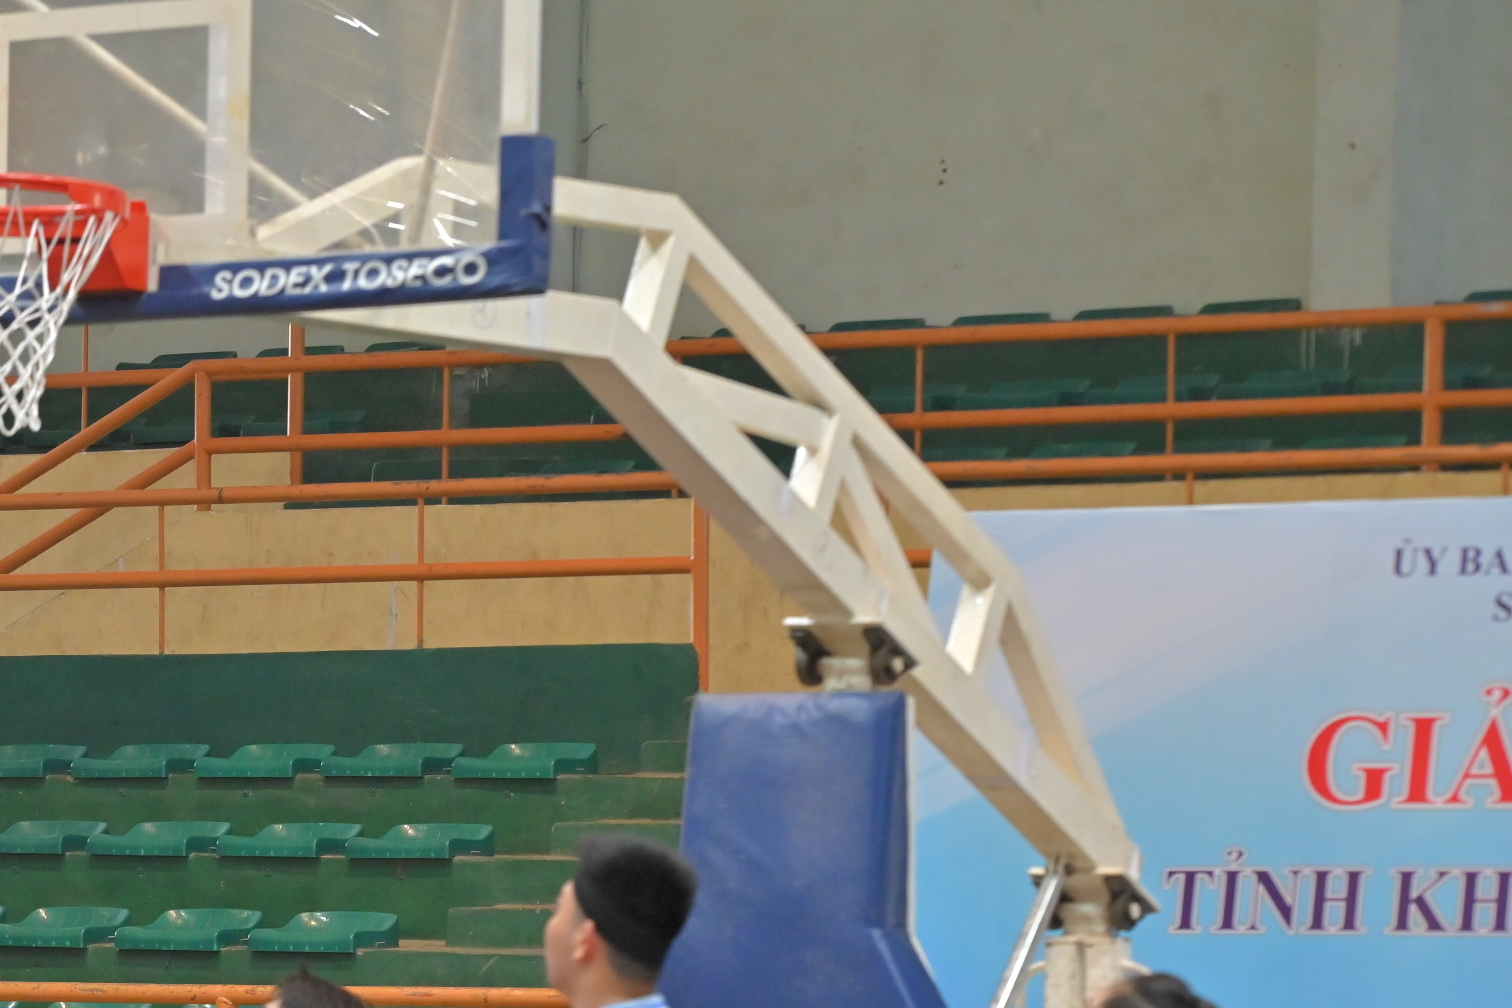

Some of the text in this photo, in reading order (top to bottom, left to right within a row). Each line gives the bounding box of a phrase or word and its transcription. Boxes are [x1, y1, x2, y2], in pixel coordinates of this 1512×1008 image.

[210, 252, 488, 300] SODEX TOSECO
[1392, 537, 1512, 579] ỦY BA
[1304, 683, 1512, 809] GIẢ
[1165, 848, 1512, 935] TỈNH KH
